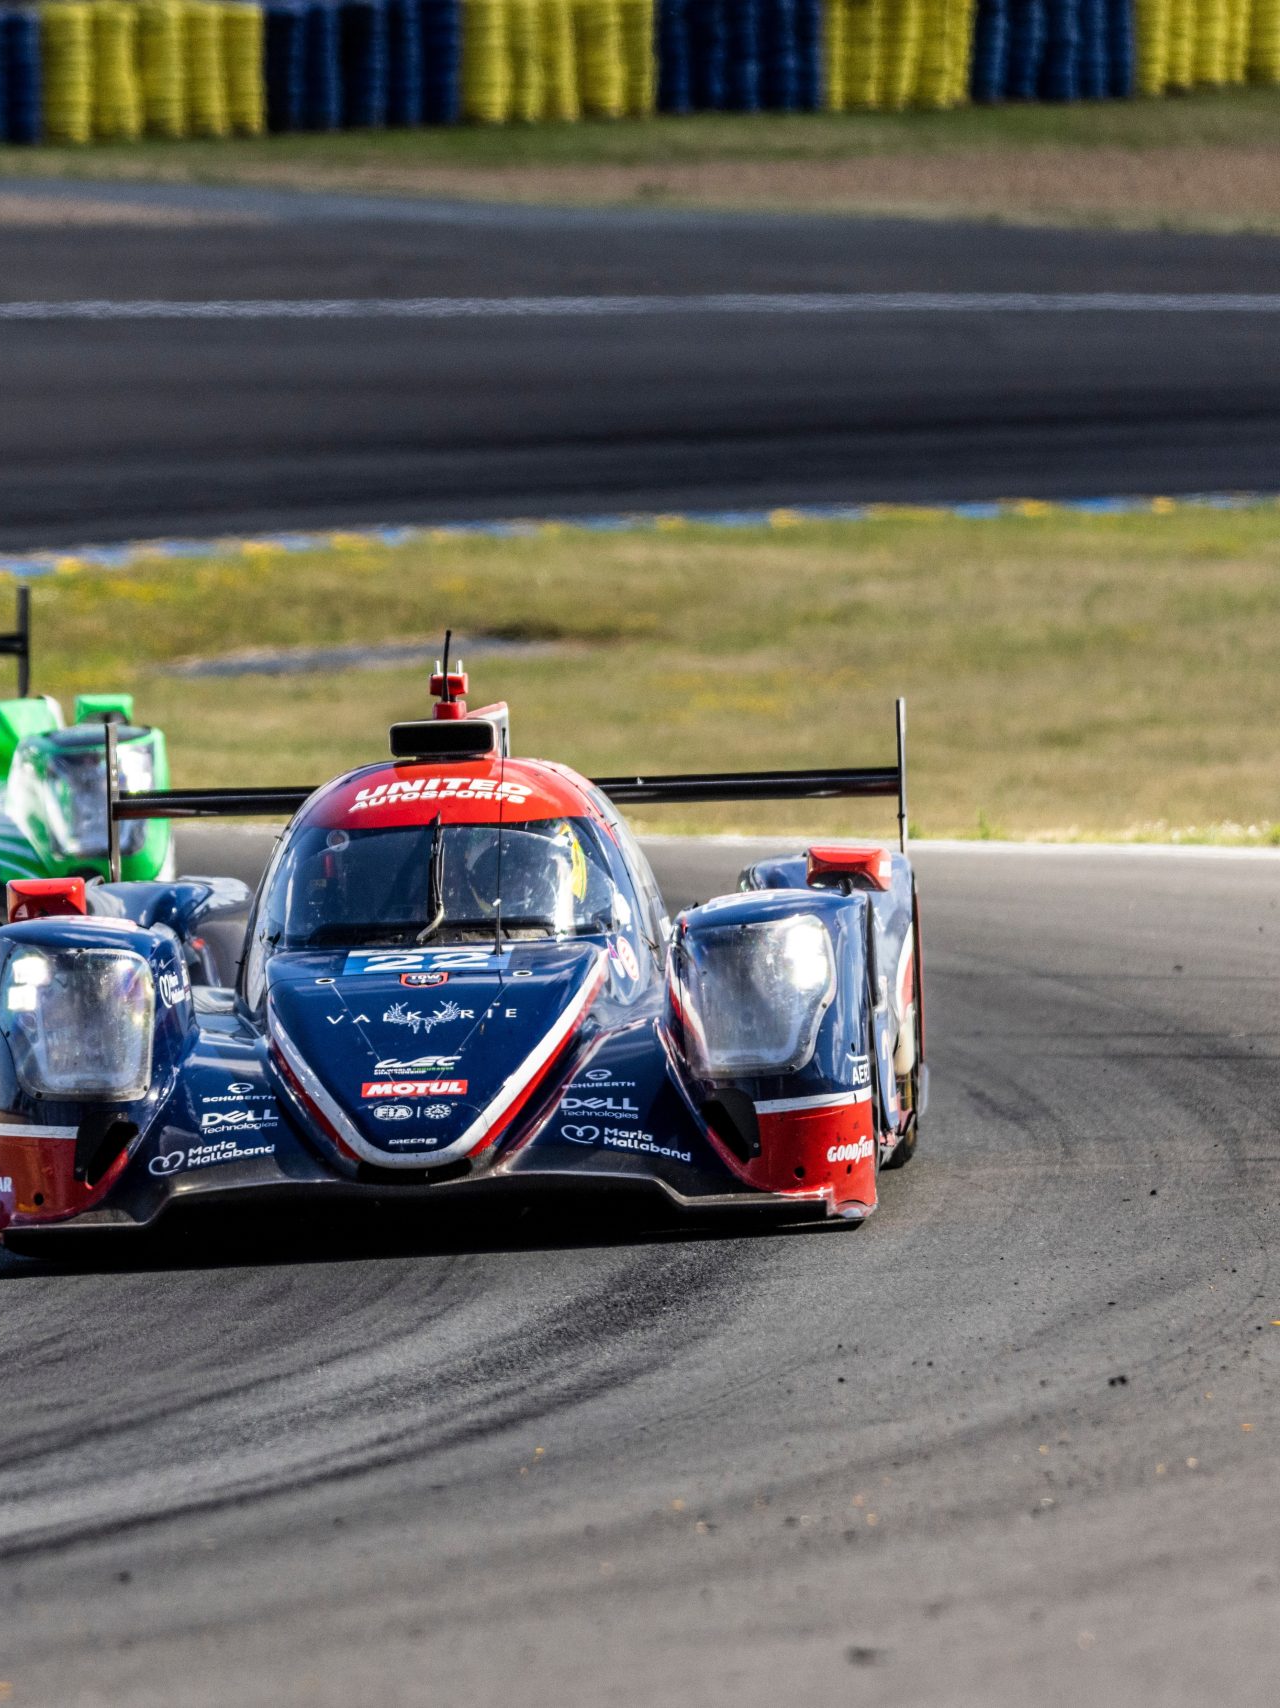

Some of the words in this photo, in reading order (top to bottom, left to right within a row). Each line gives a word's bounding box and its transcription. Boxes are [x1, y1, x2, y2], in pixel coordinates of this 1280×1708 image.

[355, 778, 533, 802] UNITED
[348, 789, 527, 814] AUTOSPORTS
[363, 952, 491, 972] 22
[409, 974, 440, 982] TOW
[326, 1008, 518, 1025] VALKYRIE
[366, 1081, 464, 1096] MOTUL
[562, 1081, 636, 1089] SCHUBERTH
[202, 1094, 276, 1103] SCHUBERTH
[561, 1097, 639, 1111] DELL
[201, 1109, 279, 1127] DELL
[376, 1107, 409, 1118] FIA
[562, 1109, 639, 1120] Technologies
[202, 1121, 278, 1135] Technologies
[603, 1127, 654, 1142] Maria
[187, 1144, 276, 1167] Mallaband
[188, 1141, 237, 1157] Maria
[603, 1136, 691, 1162] Mallaband
